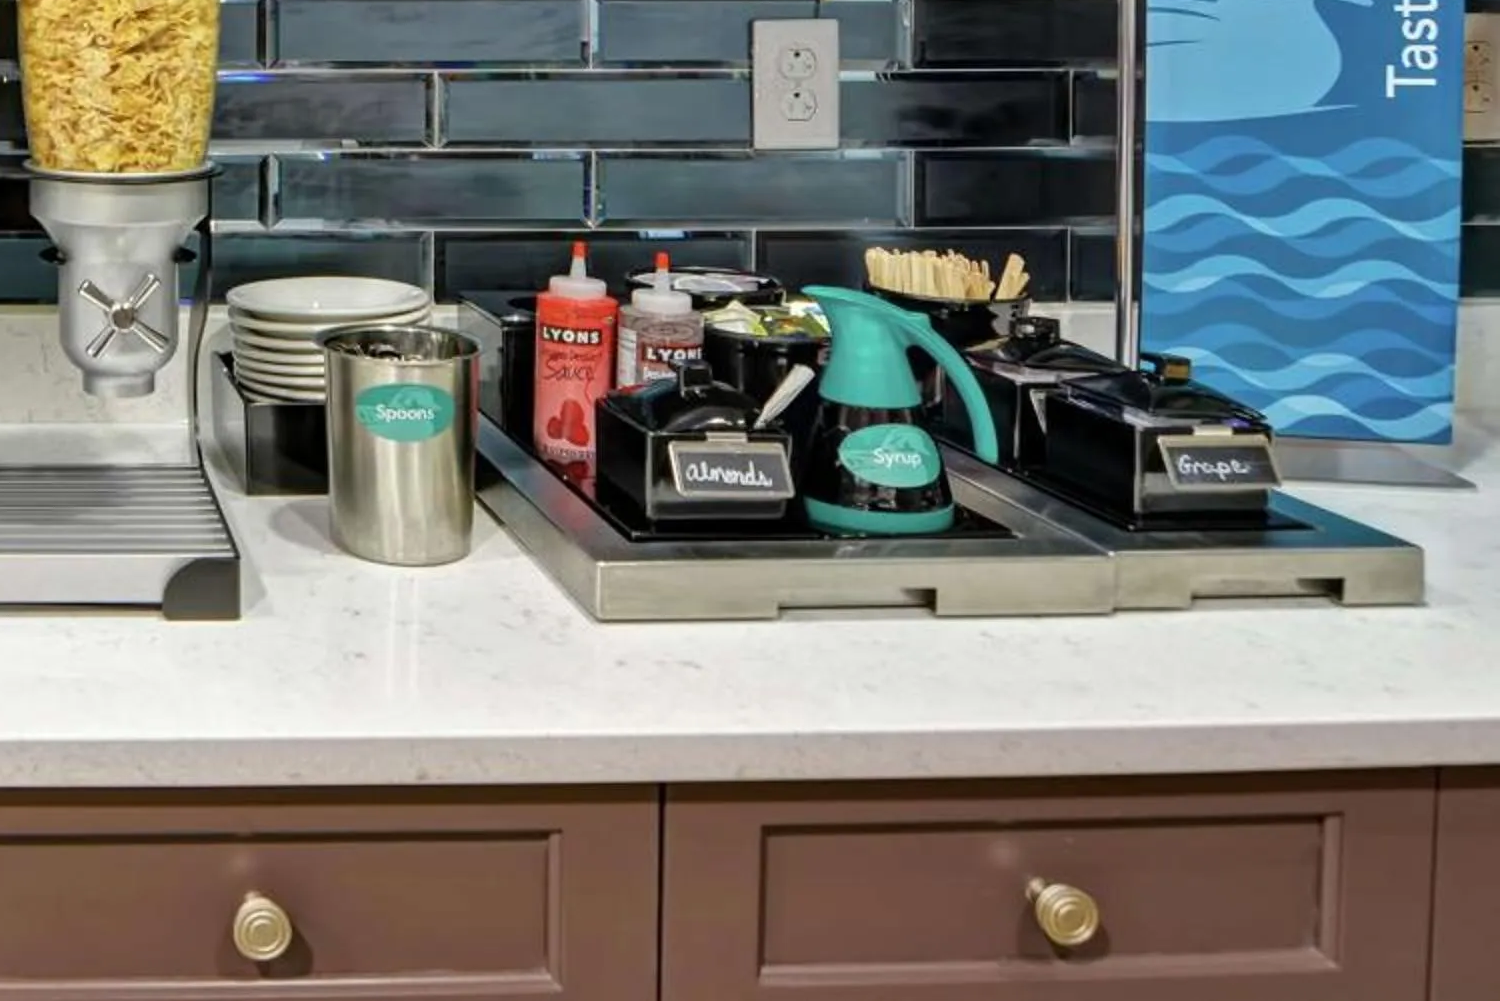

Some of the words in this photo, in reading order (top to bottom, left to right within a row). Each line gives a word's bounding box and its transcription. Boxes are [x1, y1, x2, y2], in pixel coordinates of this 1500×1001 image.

[543, 326, 600, 344] LYONS
[375, 404, 435, 422] Spoons
[873, 448, 922, 469] Syrup
[1178, 455, 1249, 480] Grape
